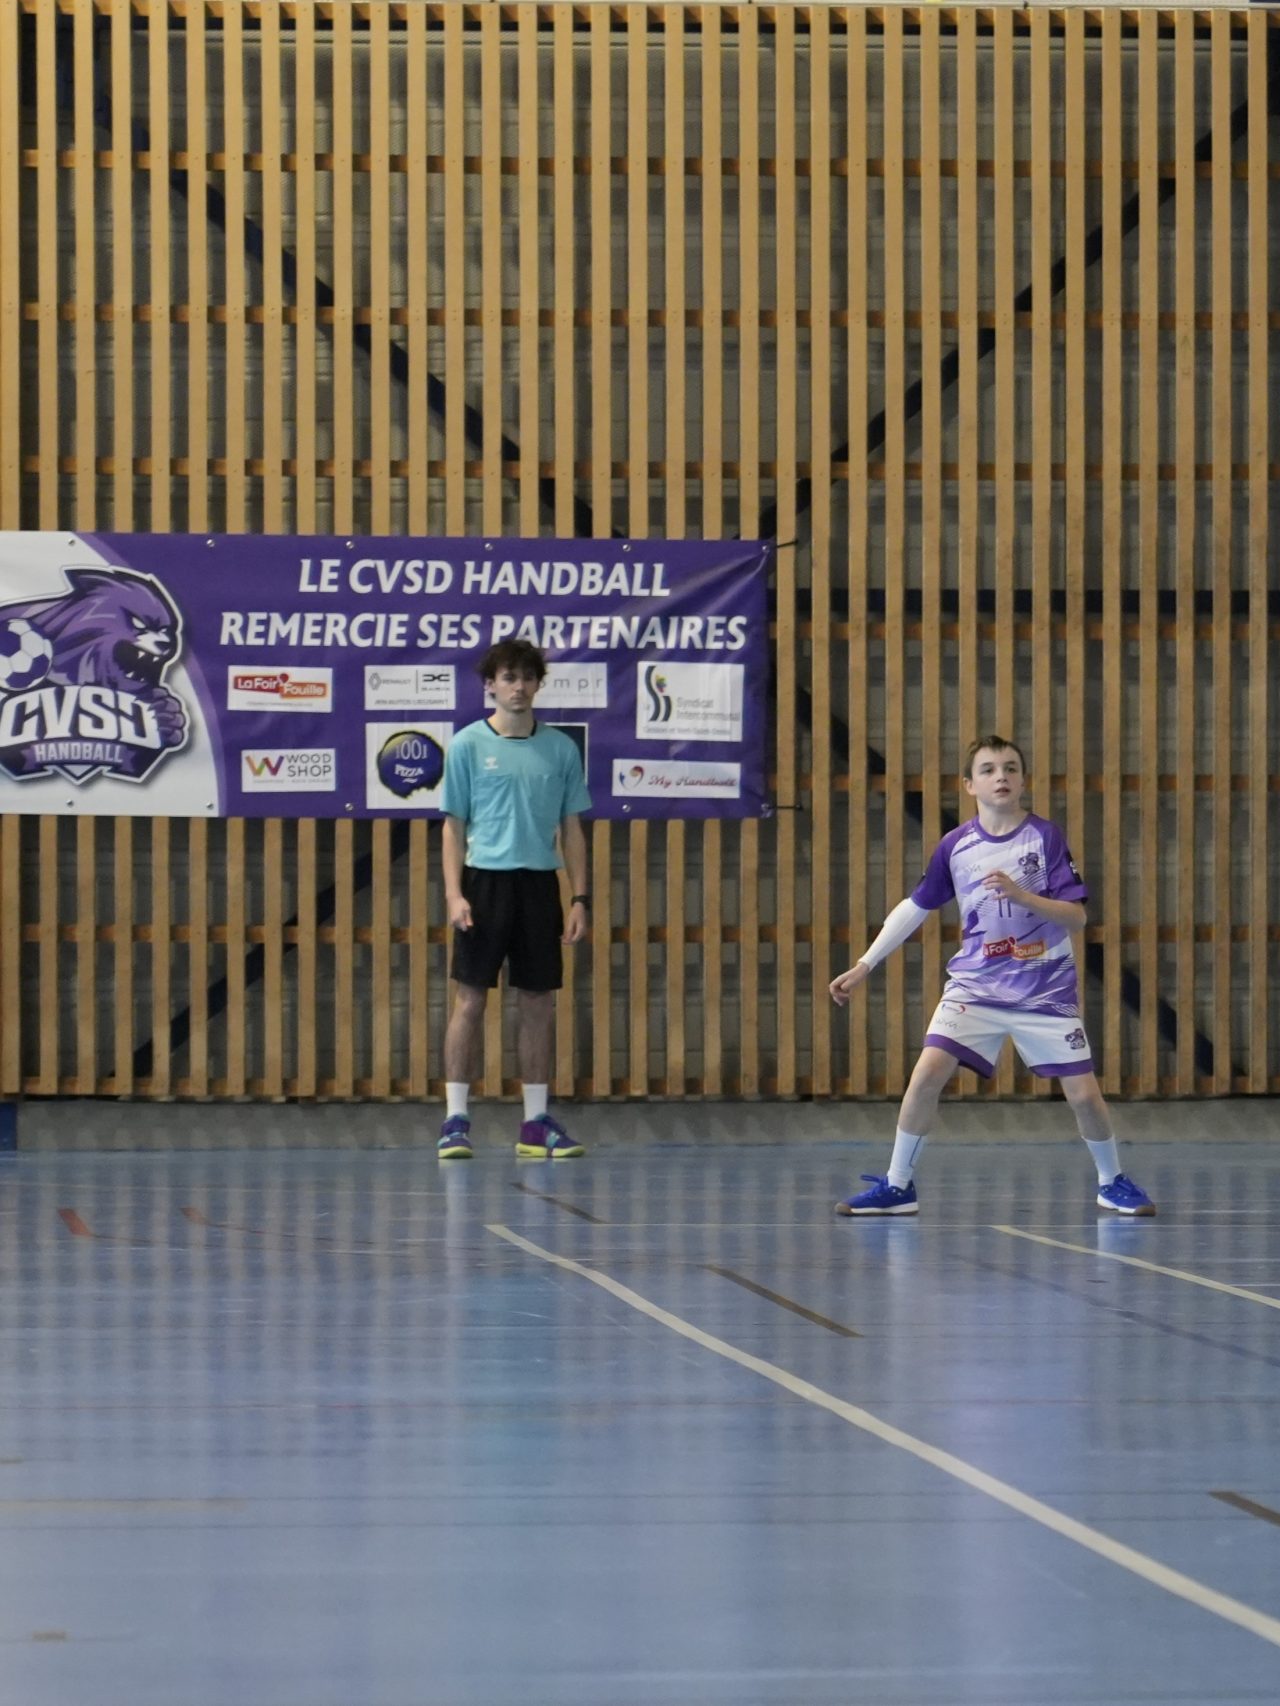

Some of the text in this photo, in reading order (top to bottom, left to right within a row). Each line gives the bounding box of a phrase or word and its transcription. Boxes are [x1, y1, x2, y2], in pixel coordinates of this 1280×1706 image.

[299, 559, 670, 596] LE CVSD HANDBALL
[220, 612, 748, 650] REMERCIE SES PARTENAIRES
[238, 678, 253, 689] La
[0, 685, 161, 750] CVSD
[35, 742, 124, 762] HANDBALL
[287, 753, 332, 764] WOOD
[396, 740, 428, 760] 1001
[288, 764, 332, 777] SHOP
[394, 764, 424, 778] PIZZA
